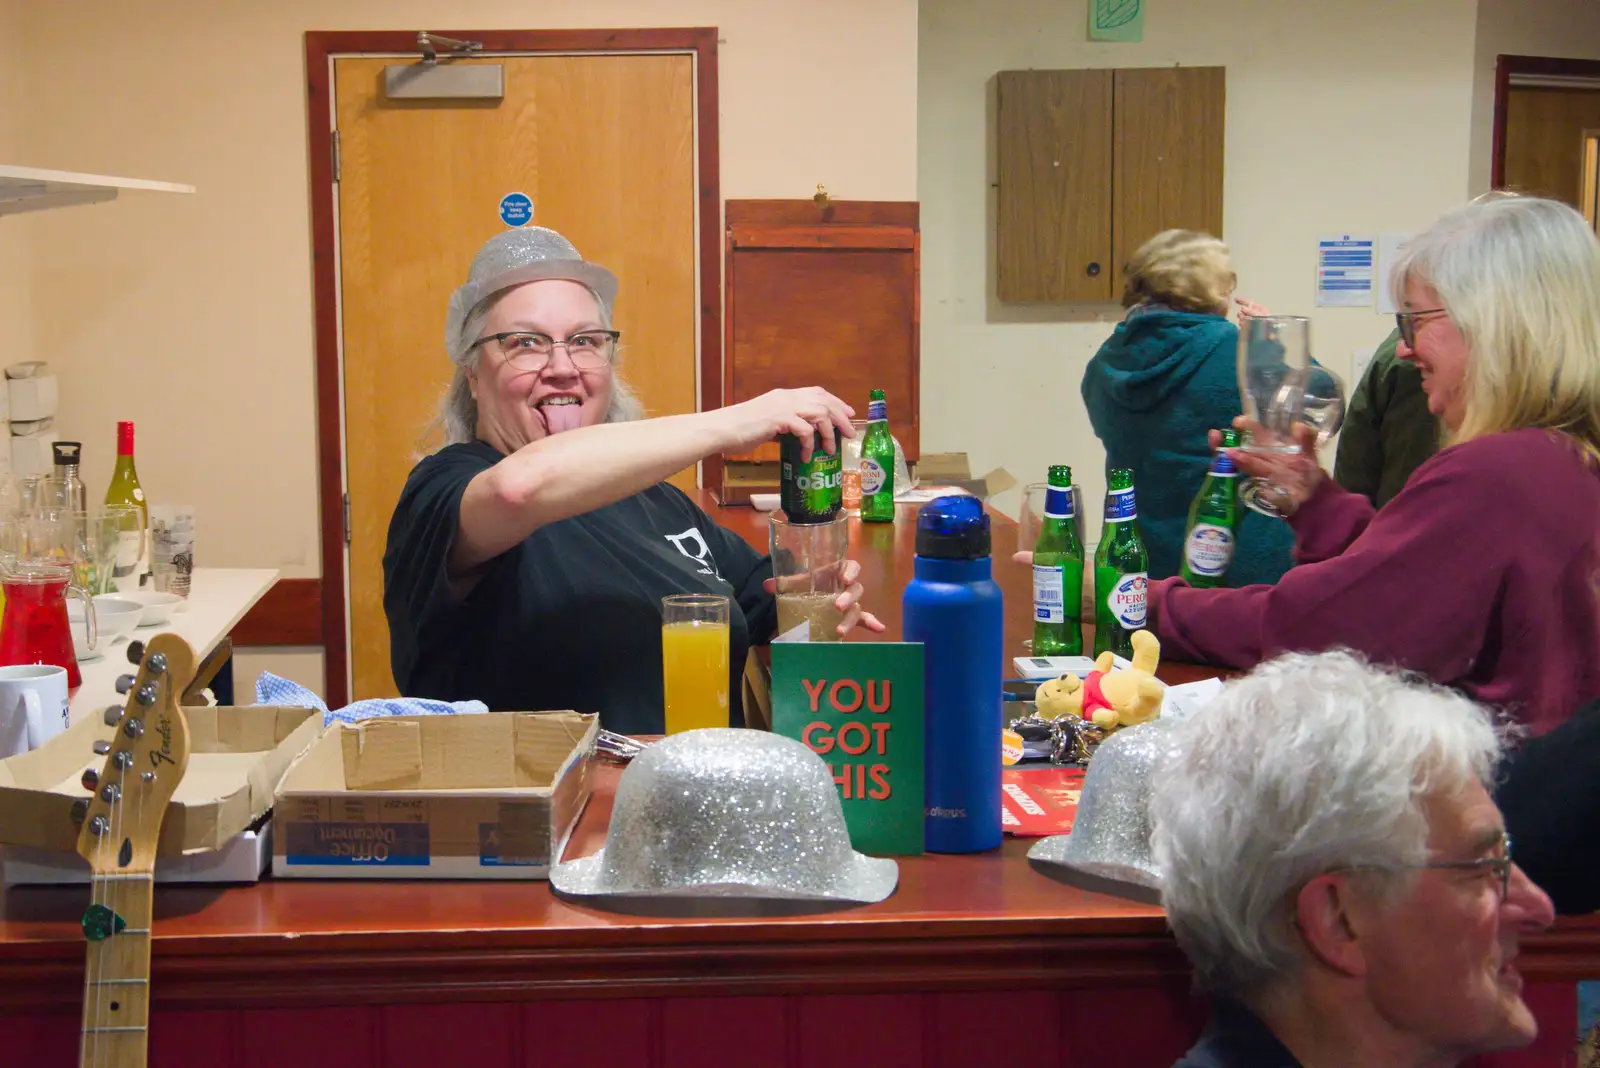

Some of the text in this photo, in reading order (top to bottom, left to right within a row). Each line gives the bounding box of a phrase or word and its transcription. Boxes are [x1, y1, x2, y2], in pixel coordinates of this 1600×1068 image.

[797, 471, 842, 490] ango
[1117, 592, 1146, 604] PERO
[801, 679, 891, 713] YOU
[150, 719, 175, 768] Fender
[801, 721, 891, 755] GOT
[826, 763, 892, 800] HIS
[319, 827, 396, 845] Document
[331, 842, 389, 862] Office
